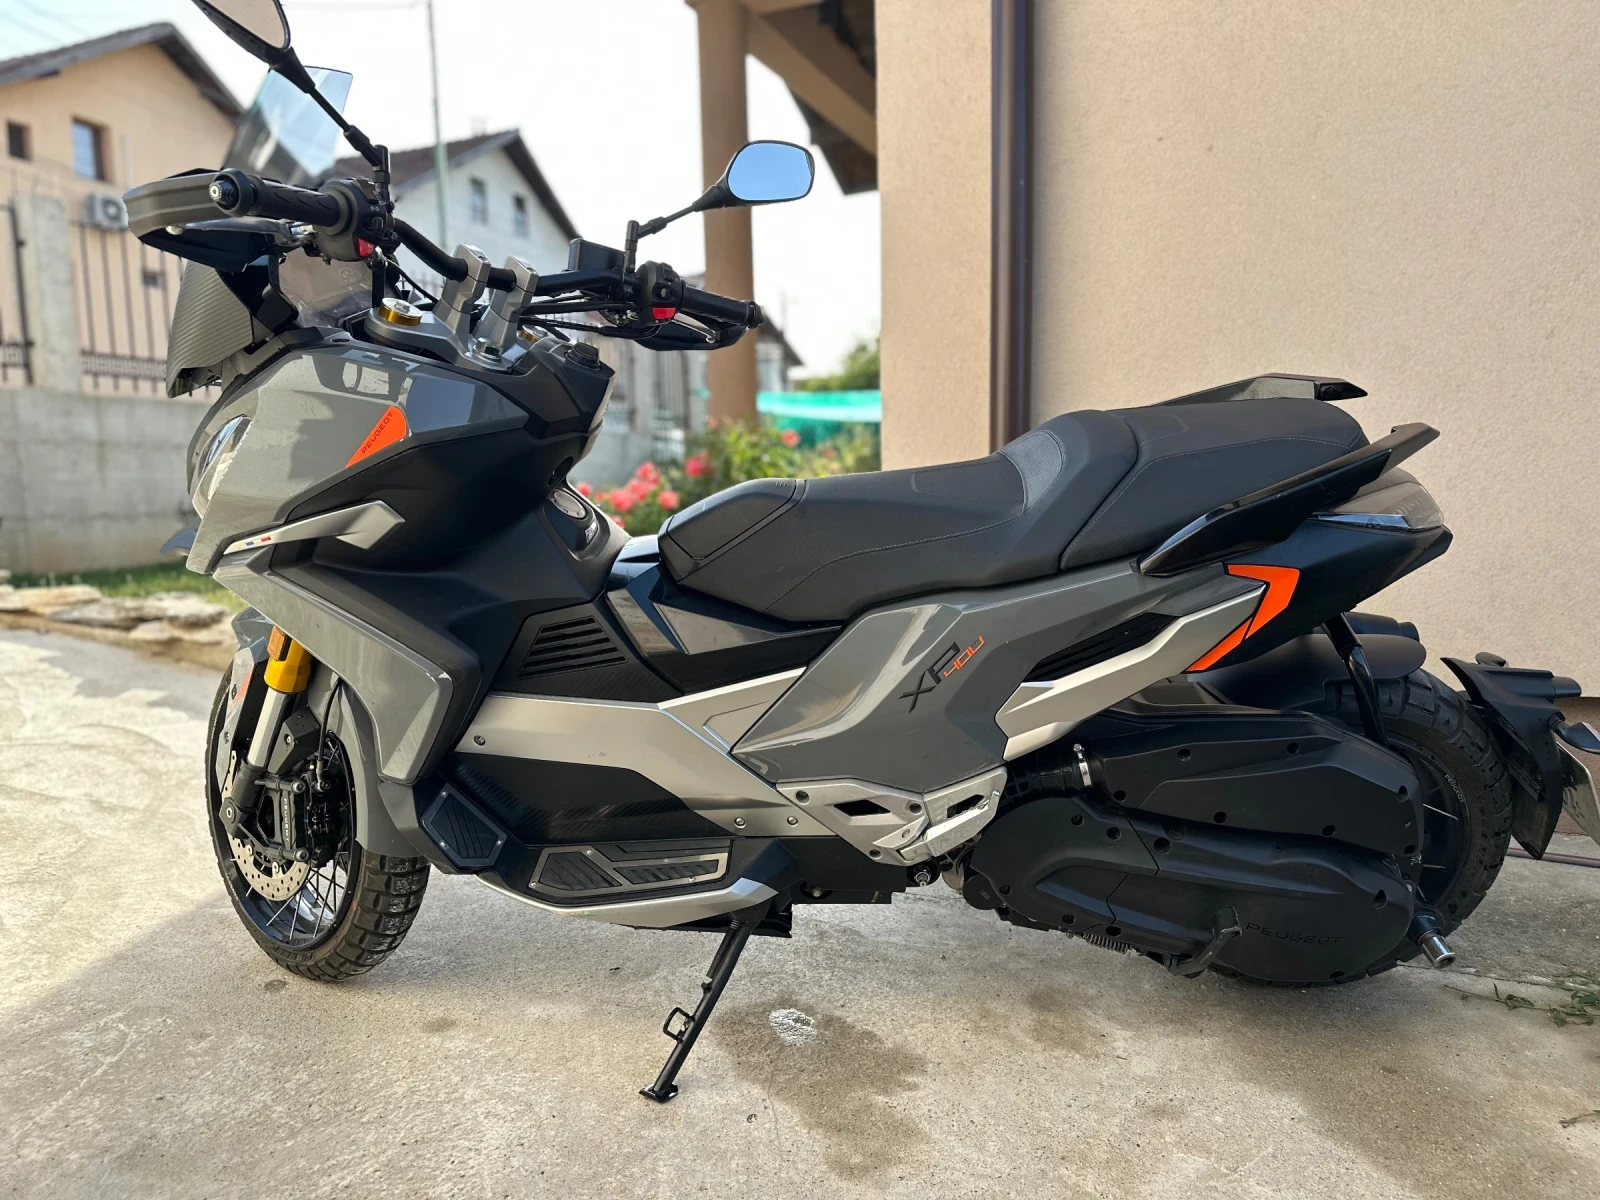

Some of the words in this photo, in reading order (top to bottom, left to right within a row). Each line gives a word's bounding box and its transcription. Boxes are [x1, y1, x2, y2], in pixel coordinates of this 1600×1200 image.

[361, 411, 394, 455] PEUGEOT
[898, 641, 961, 714] XP
[1444, 774, 1465, 803] PEUGEOT
[1245, 922, 1343, 945] PEUGEOT
